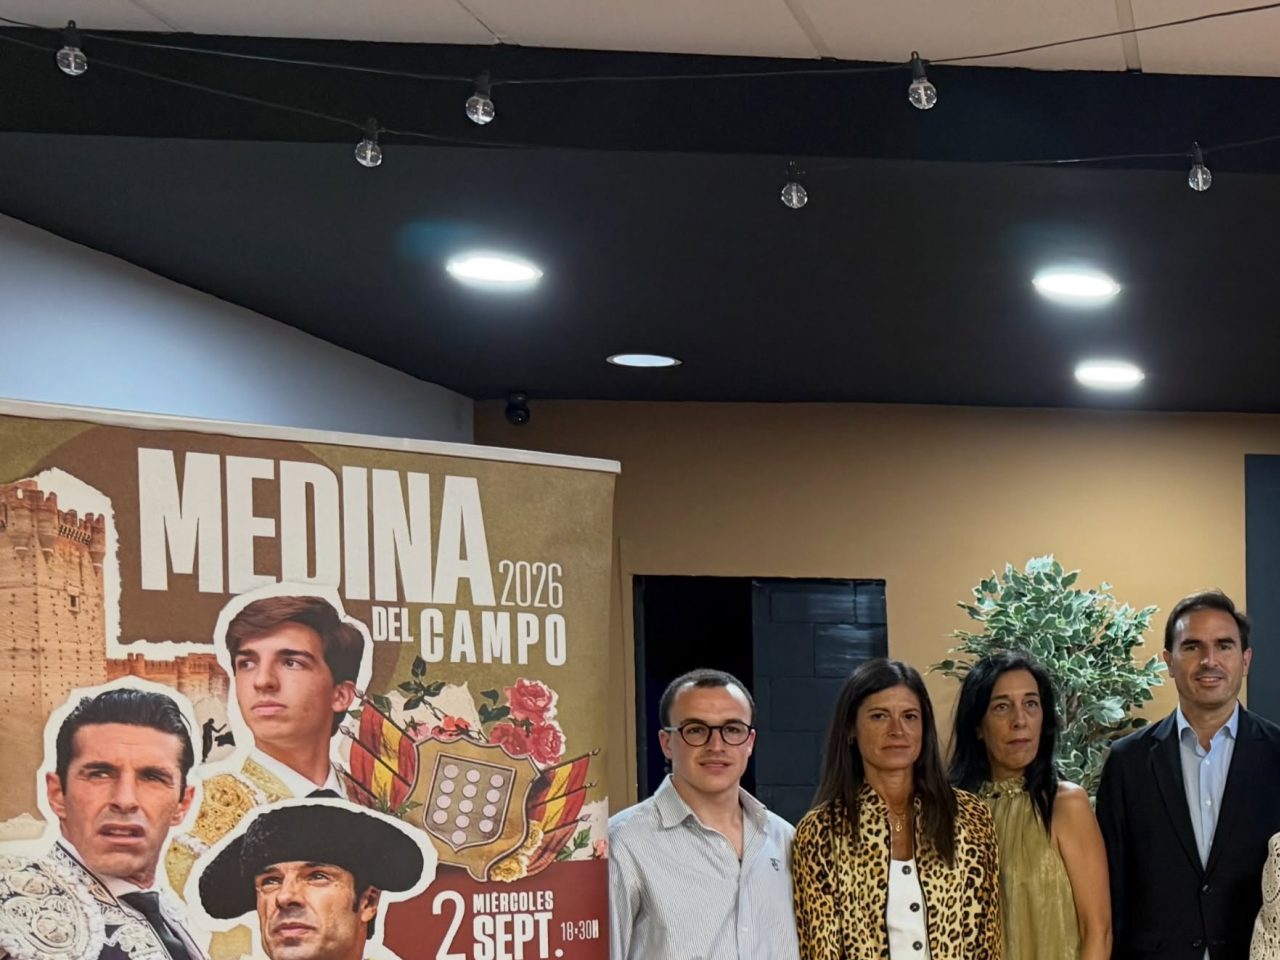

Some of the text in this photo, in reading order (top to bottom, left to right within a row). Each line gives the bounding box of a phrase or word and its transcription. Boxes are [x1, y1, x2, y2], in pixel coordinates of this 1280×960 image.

[137, 447, 497, 606] MEDINA
[499, 560, 564, 608] 2026
[372, 606, 566, 666] DEL CAMPO
